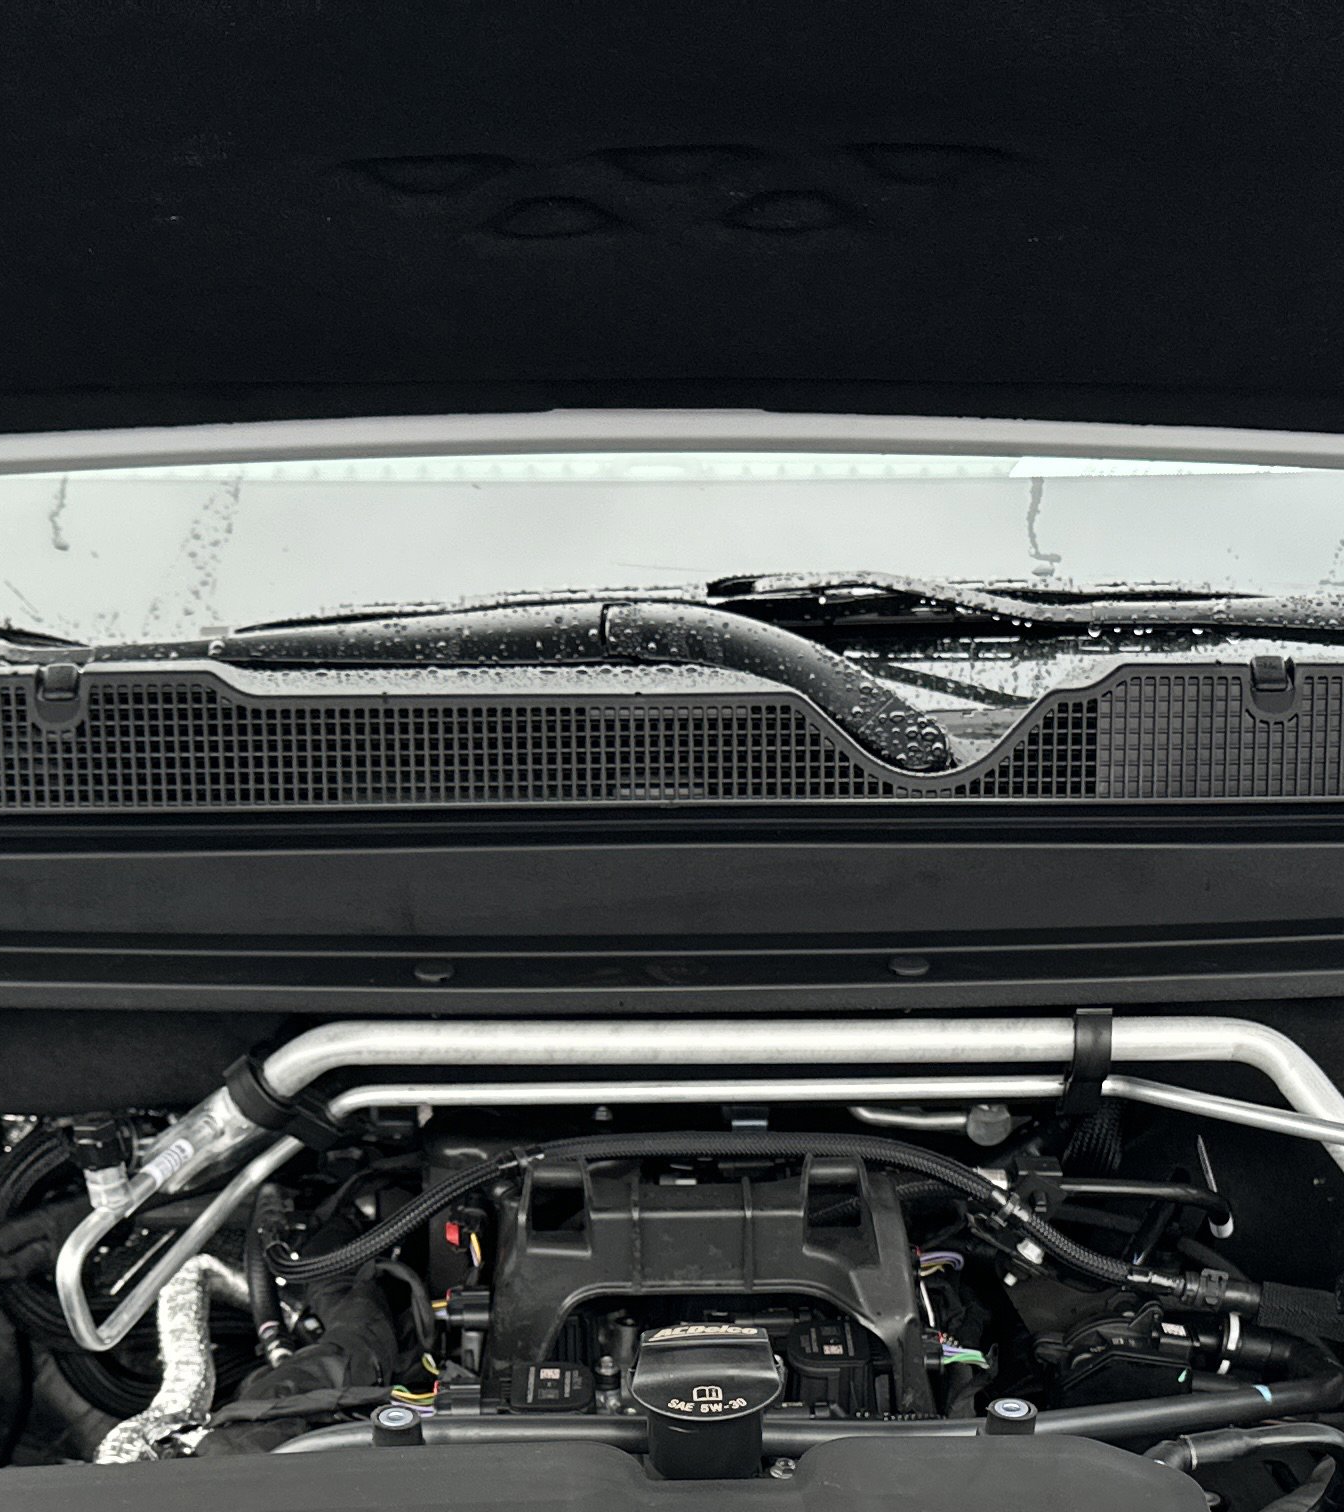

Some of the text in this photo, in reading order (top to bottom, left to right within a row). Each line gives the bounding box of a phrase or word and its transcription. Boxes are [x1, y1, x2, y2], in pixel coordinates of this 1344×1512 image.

[649, 1324, 759, 1341] ACDelco
[667, 1397, 748, 1414] SAE 5W-30
